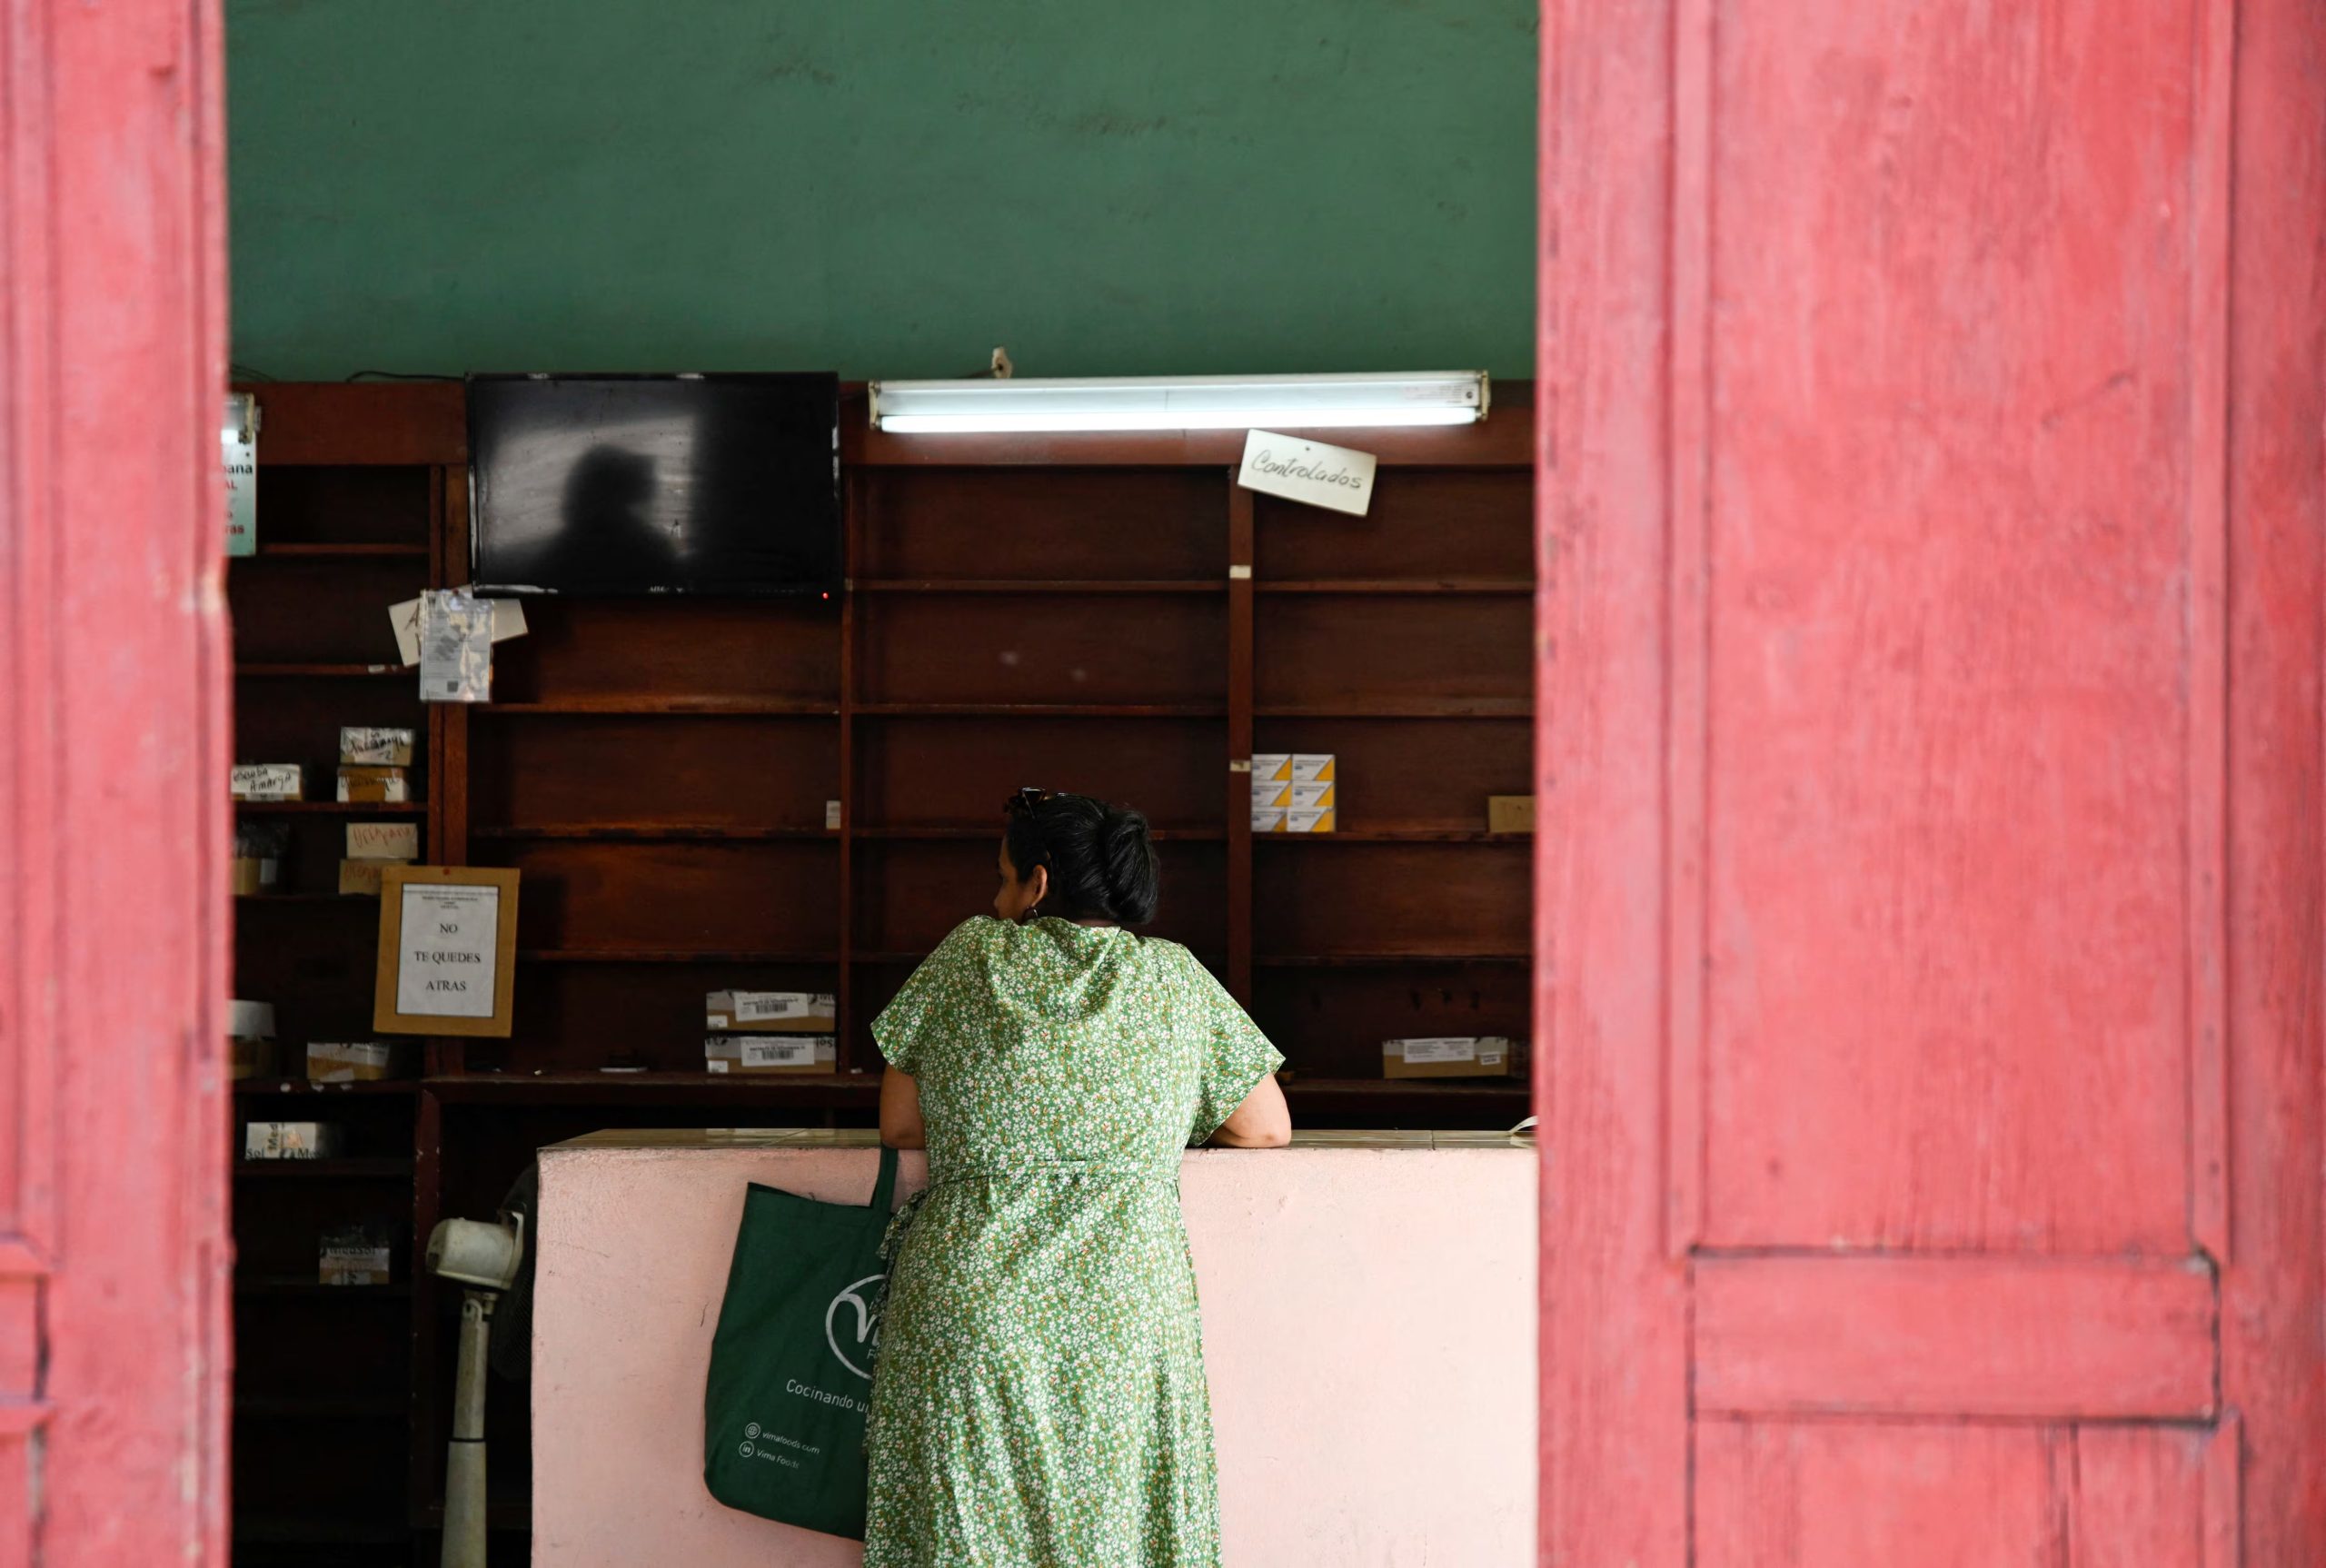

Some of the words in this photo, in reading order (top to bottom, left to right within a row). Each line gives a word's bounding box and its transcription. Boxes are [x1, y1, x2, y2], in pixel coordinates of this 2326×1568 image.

[224, 464, 253, 474] ana
[1251, 450, 1362, 489] Controlados
[439, 923, 458, 934] NO
[414, 950, 429, 962] TE
[432, 951, 481, 965] QUEDES
[425, 980, 467, 992] ATRAS
[786, 1379, 854, 1409] Cocinando
[762, 1431, 820, 1454] vimafoodscom
